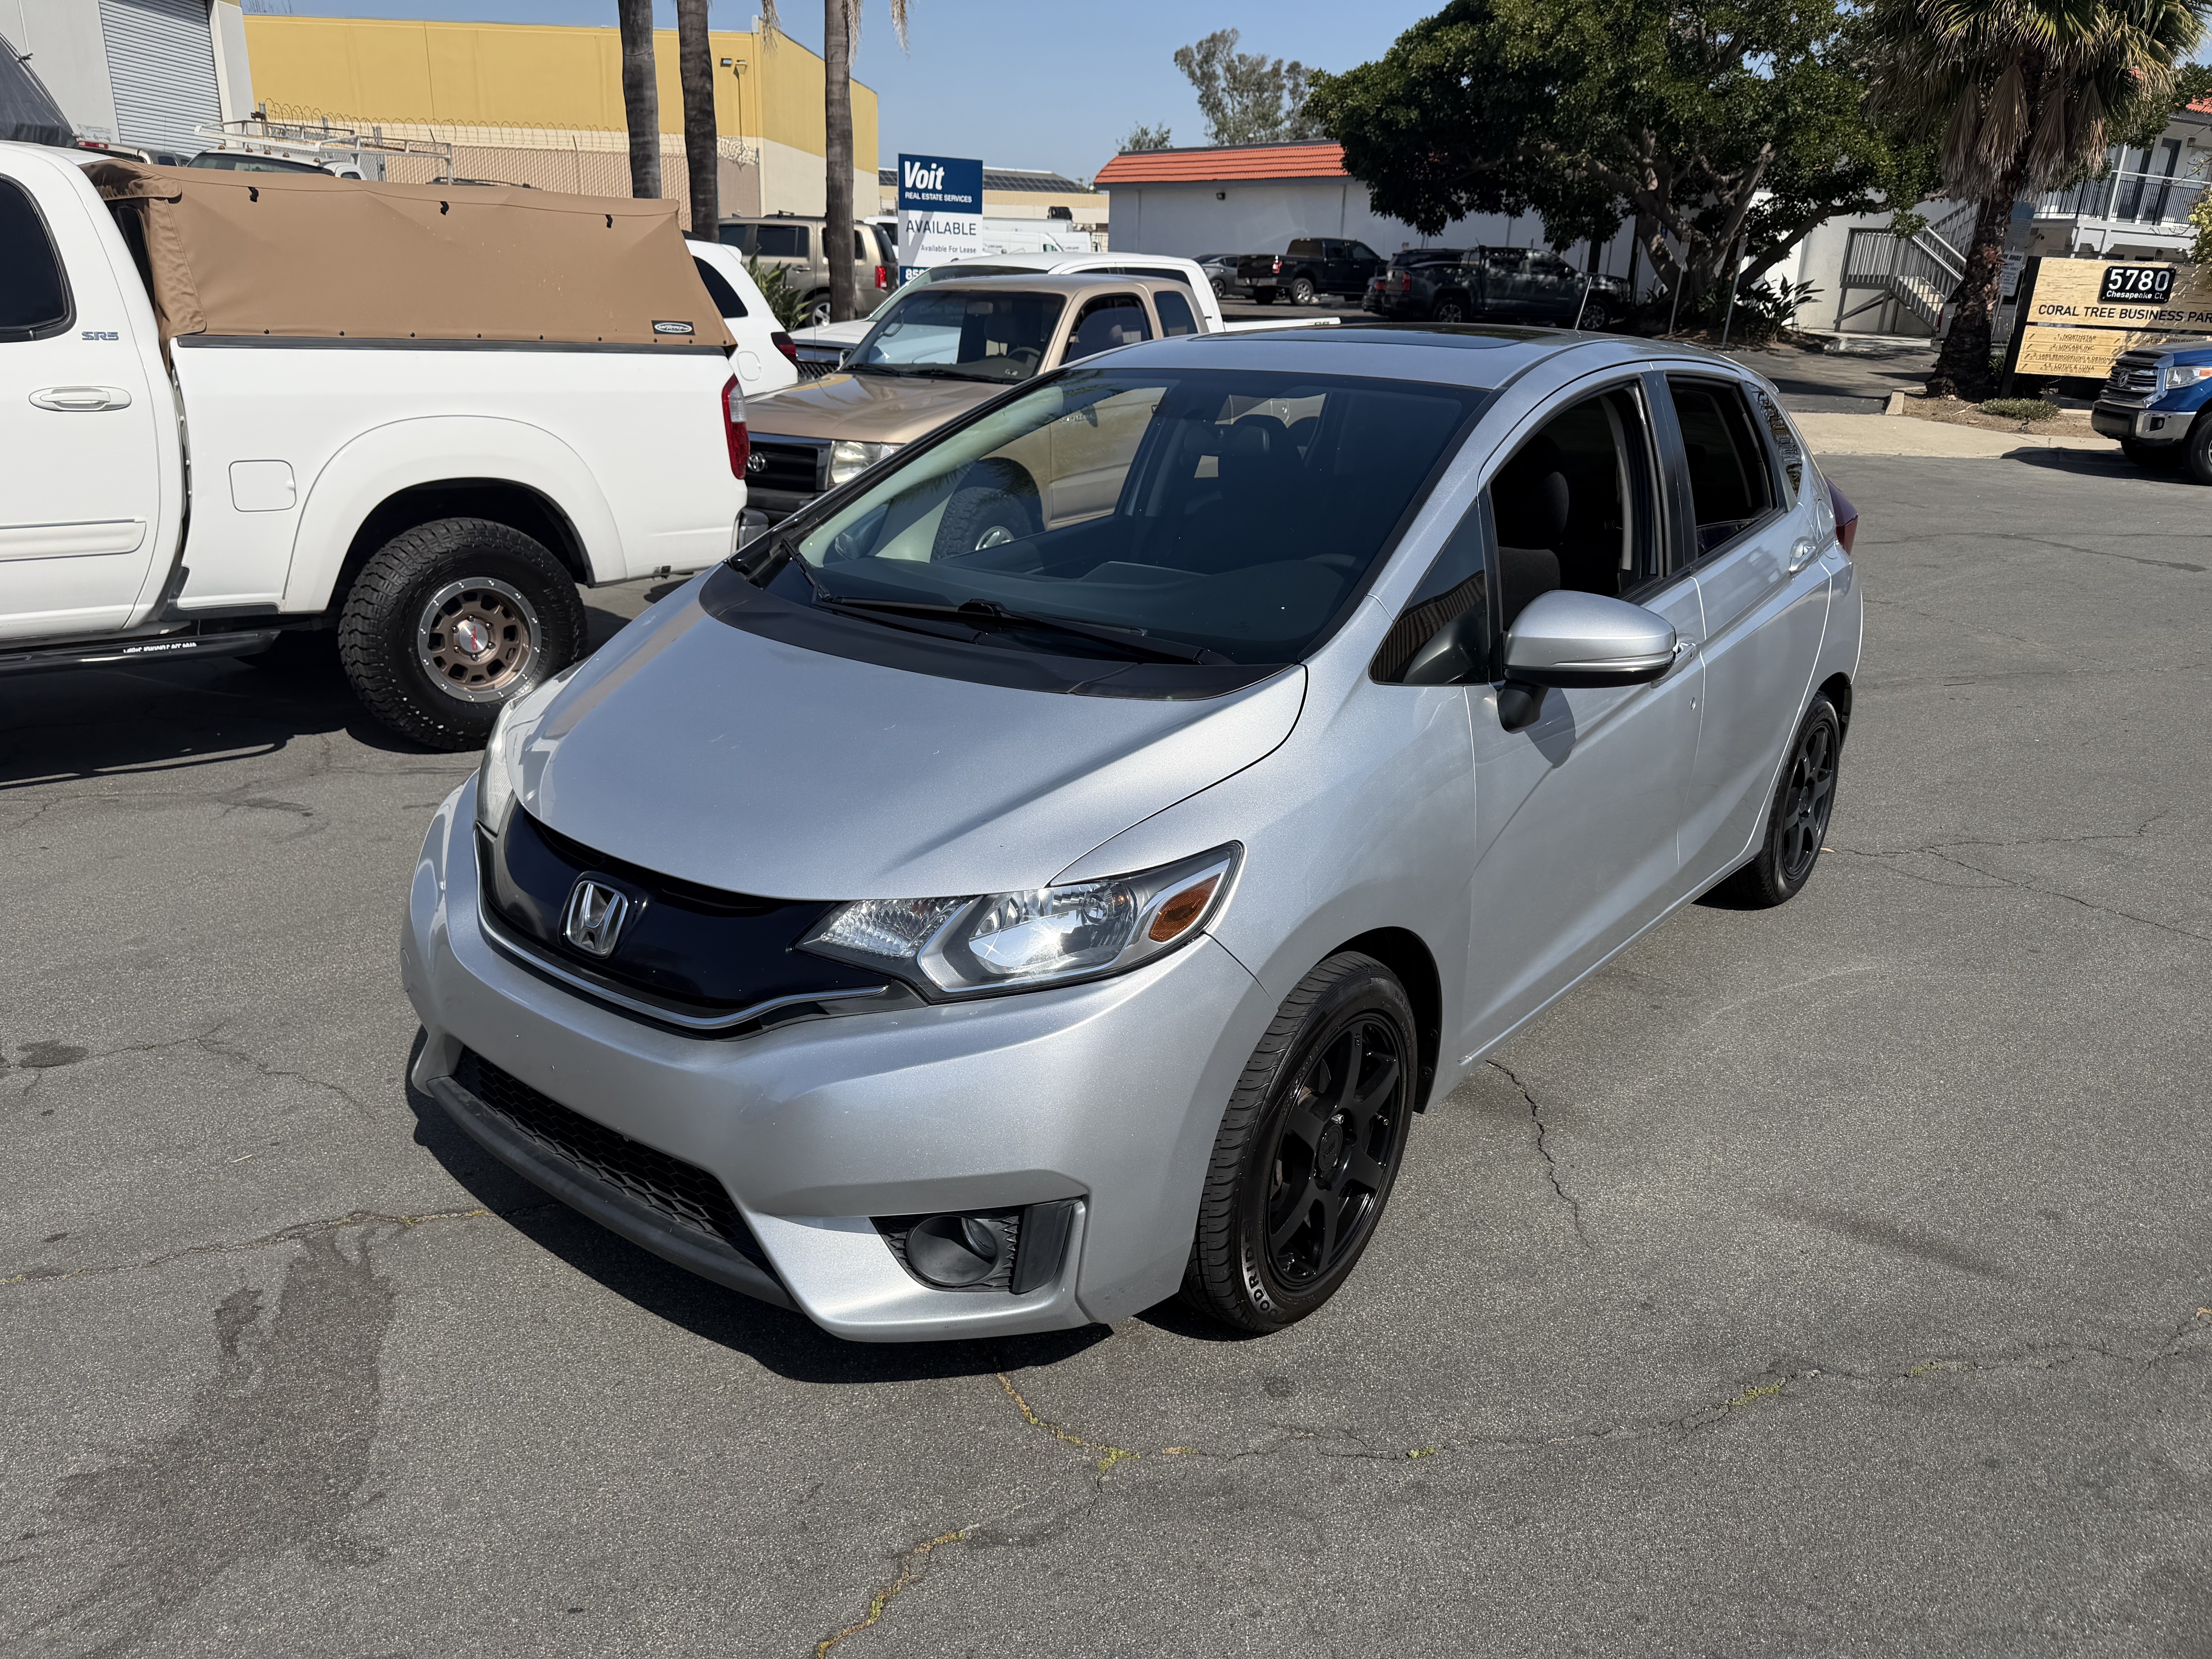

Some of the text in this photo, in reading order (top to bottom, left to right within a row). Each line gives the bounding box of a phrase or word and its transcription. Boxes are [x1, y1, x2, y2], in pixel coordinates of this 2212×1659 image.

[904, 160, 945, 190] Voit
[905, 191, 972, 203] REAL ESTATE SERVICES
[906, 220, 977, 235] AVAILABLE
[921, 244, 947, 252] Available
[2109, 269, 2169, 291] 5780
[2106, 290, 2152, 300] Chesapeake
[2039, 304, 2079, 316] CORAL
[2083, 306, 2116, 318] TREE
[2118, 309, 2184, 321] BUSINESS
[82, 331, 119, 341] SR5
